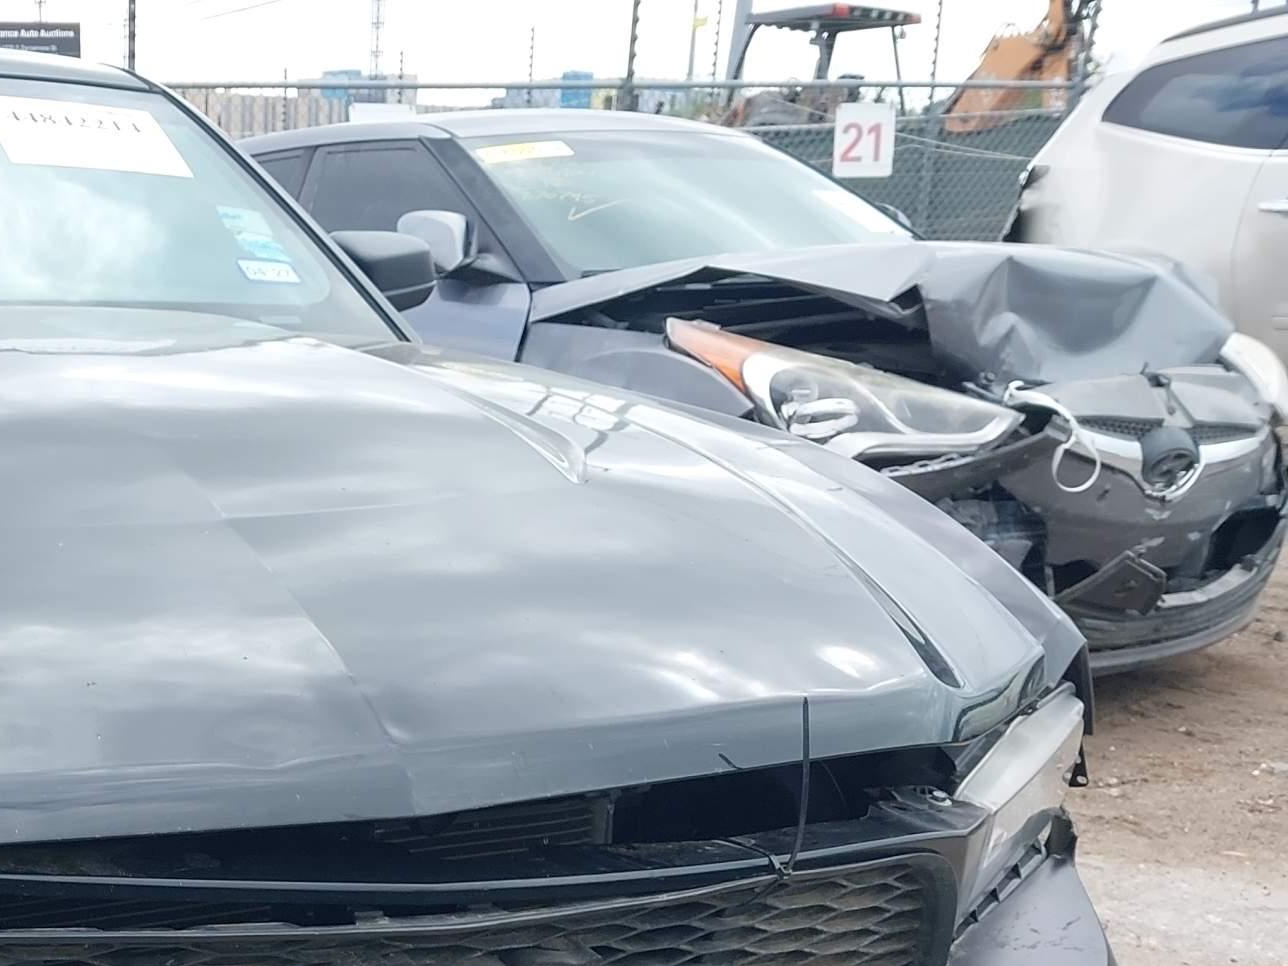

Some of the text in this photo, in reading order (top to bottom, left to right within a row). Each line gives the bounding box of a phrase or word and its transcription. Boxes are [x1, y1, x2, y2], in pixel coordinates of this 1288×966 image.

[20, 28, 39, 38] Auto
[40, 28, 75, 38] Auctions
[841, 121, 882, 163] 21
